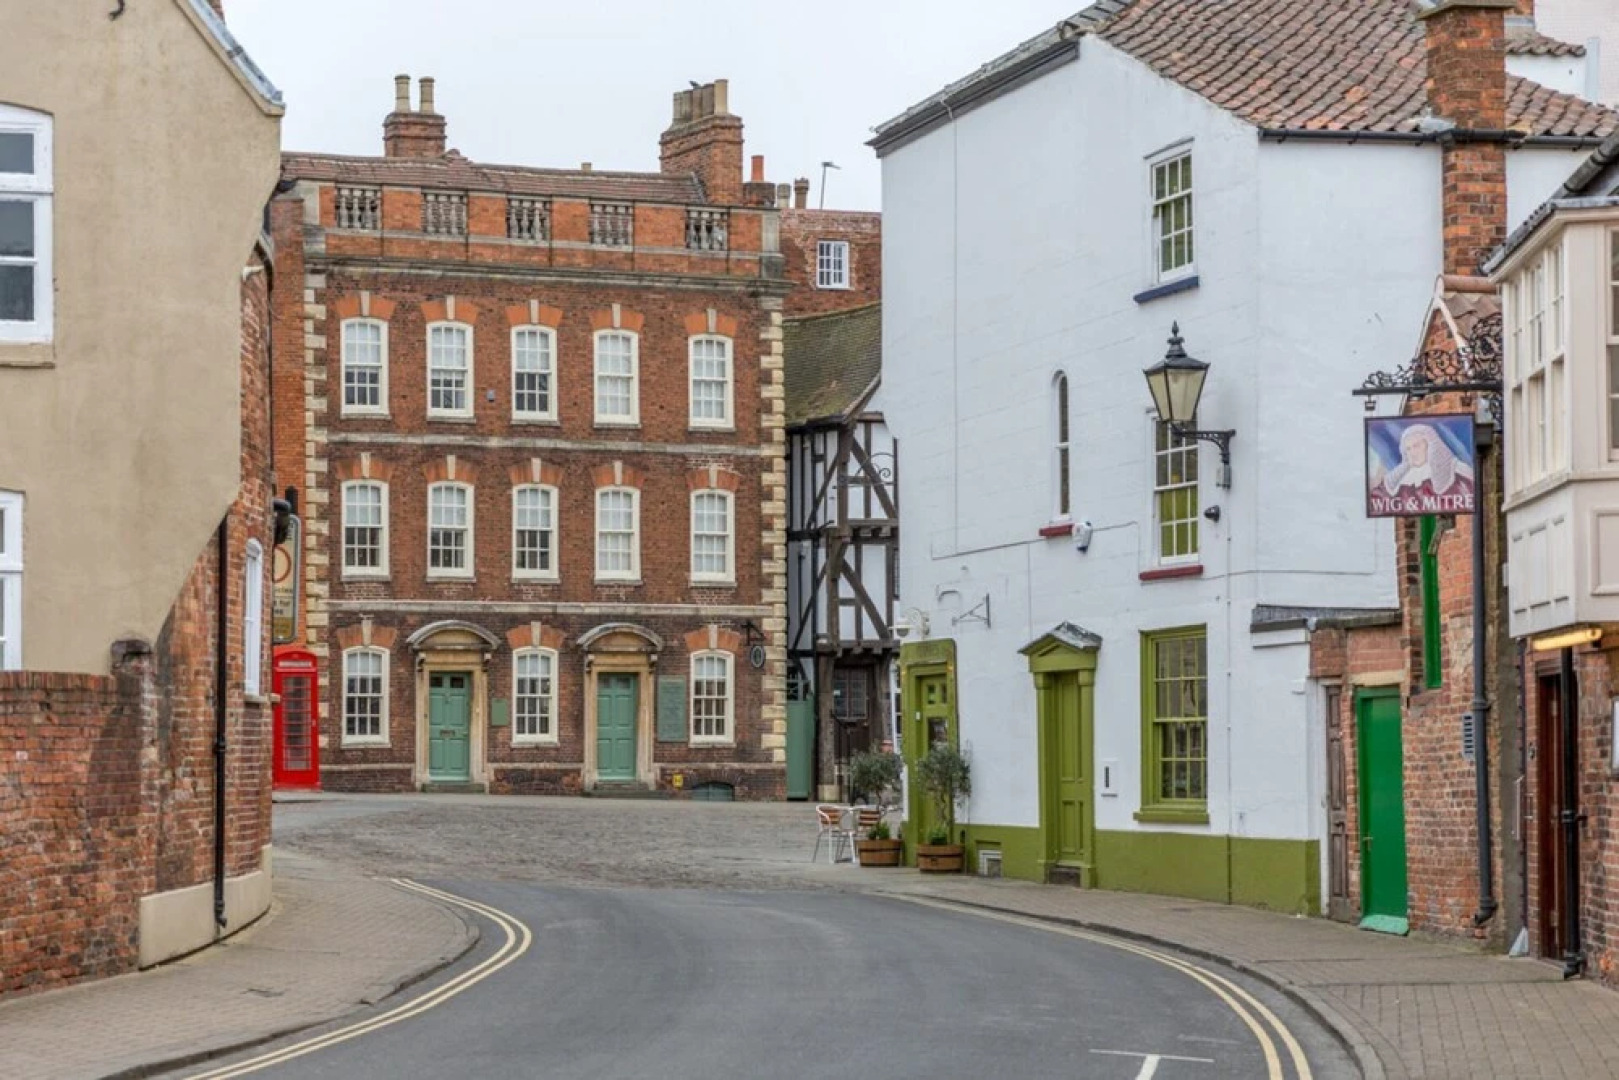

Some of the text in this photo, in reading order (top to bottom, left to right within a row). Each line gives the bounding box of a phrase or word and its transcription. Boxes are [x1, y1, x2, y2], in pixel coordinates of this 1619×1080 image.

[1372, 494, 1474, 511] WIG & MITRE
